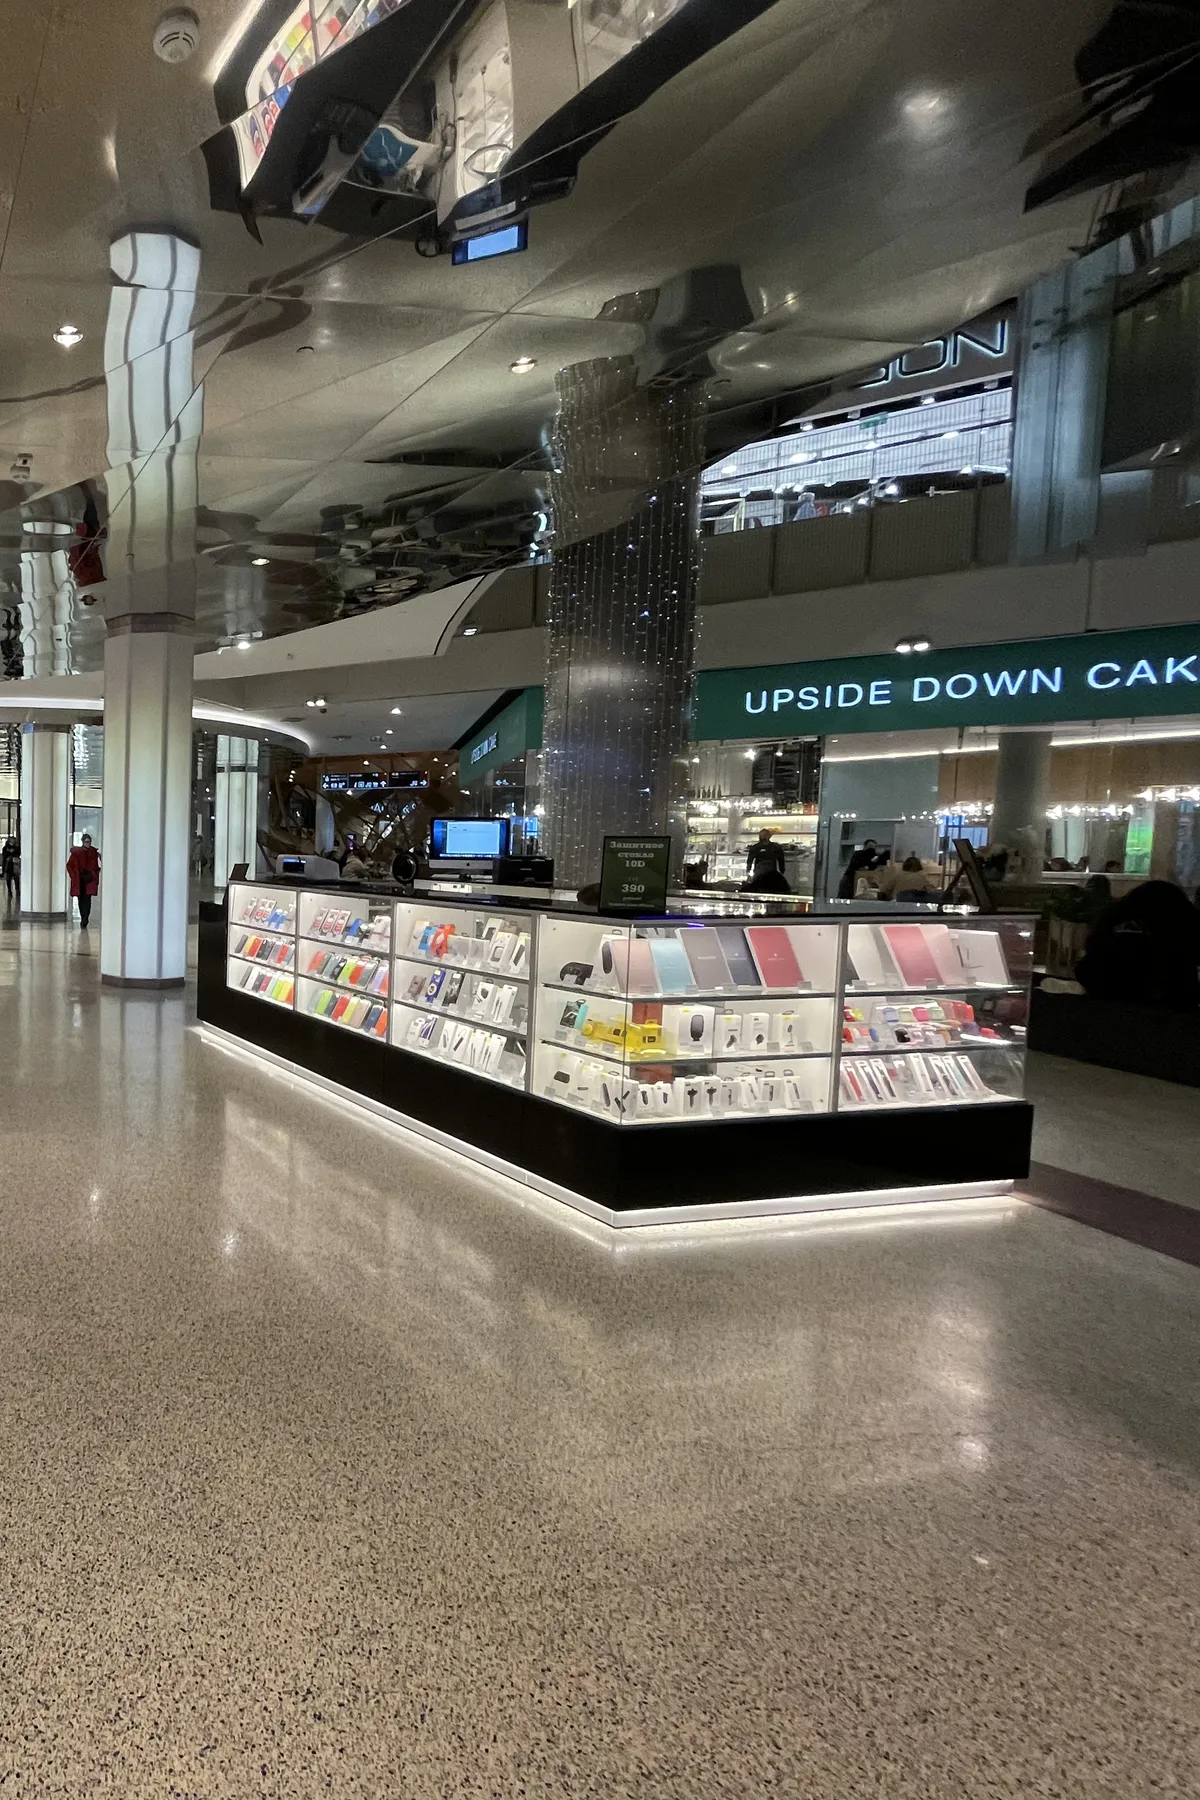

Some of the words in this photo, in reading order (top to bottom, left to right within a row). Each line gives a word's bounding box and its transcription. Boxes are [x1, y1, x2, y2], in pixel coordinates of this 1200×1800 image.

[744, 680, 893, 714] UPSIDE
[912, 667, 1062, 702] DOWN
[1086, 655, 1198, 690] CAK
[625, 860, 646, 868] 10D
[621, 883, 645, 893] 390
